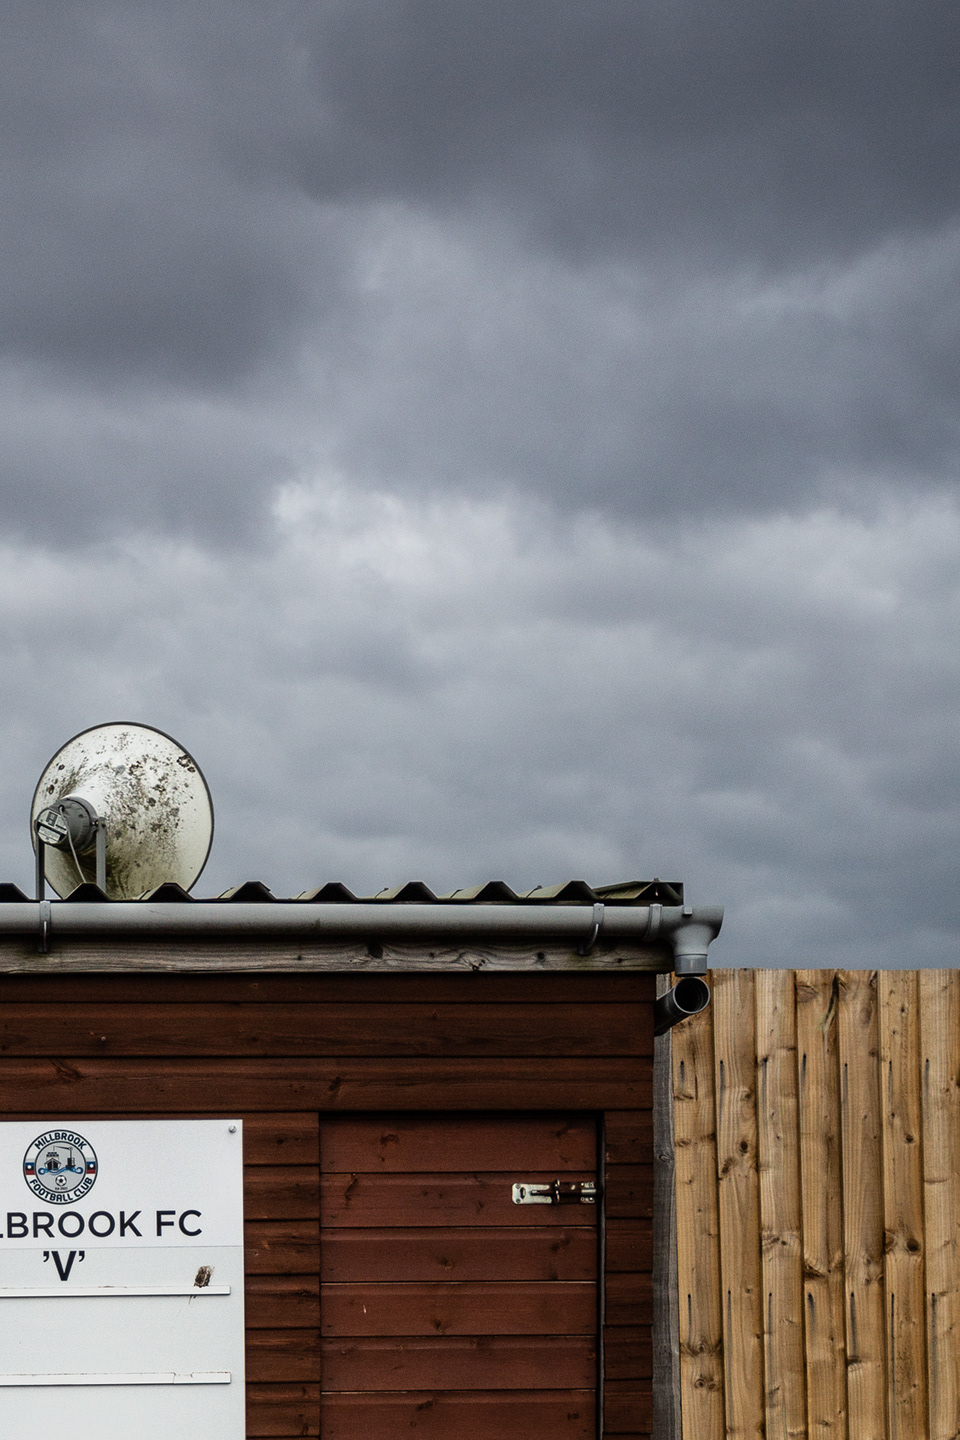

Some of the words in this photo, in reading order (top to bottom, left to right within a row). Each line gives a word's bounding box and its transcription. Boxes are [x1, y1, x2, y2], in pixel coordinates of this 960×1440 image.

[34, 1132, 87, 1150] MILLBROOK
[30, 1178, 73, 1202] FOOTBALL
[73, 1176, 93, 1197] CLUB
[156, 1209, 203, 1237] FC
